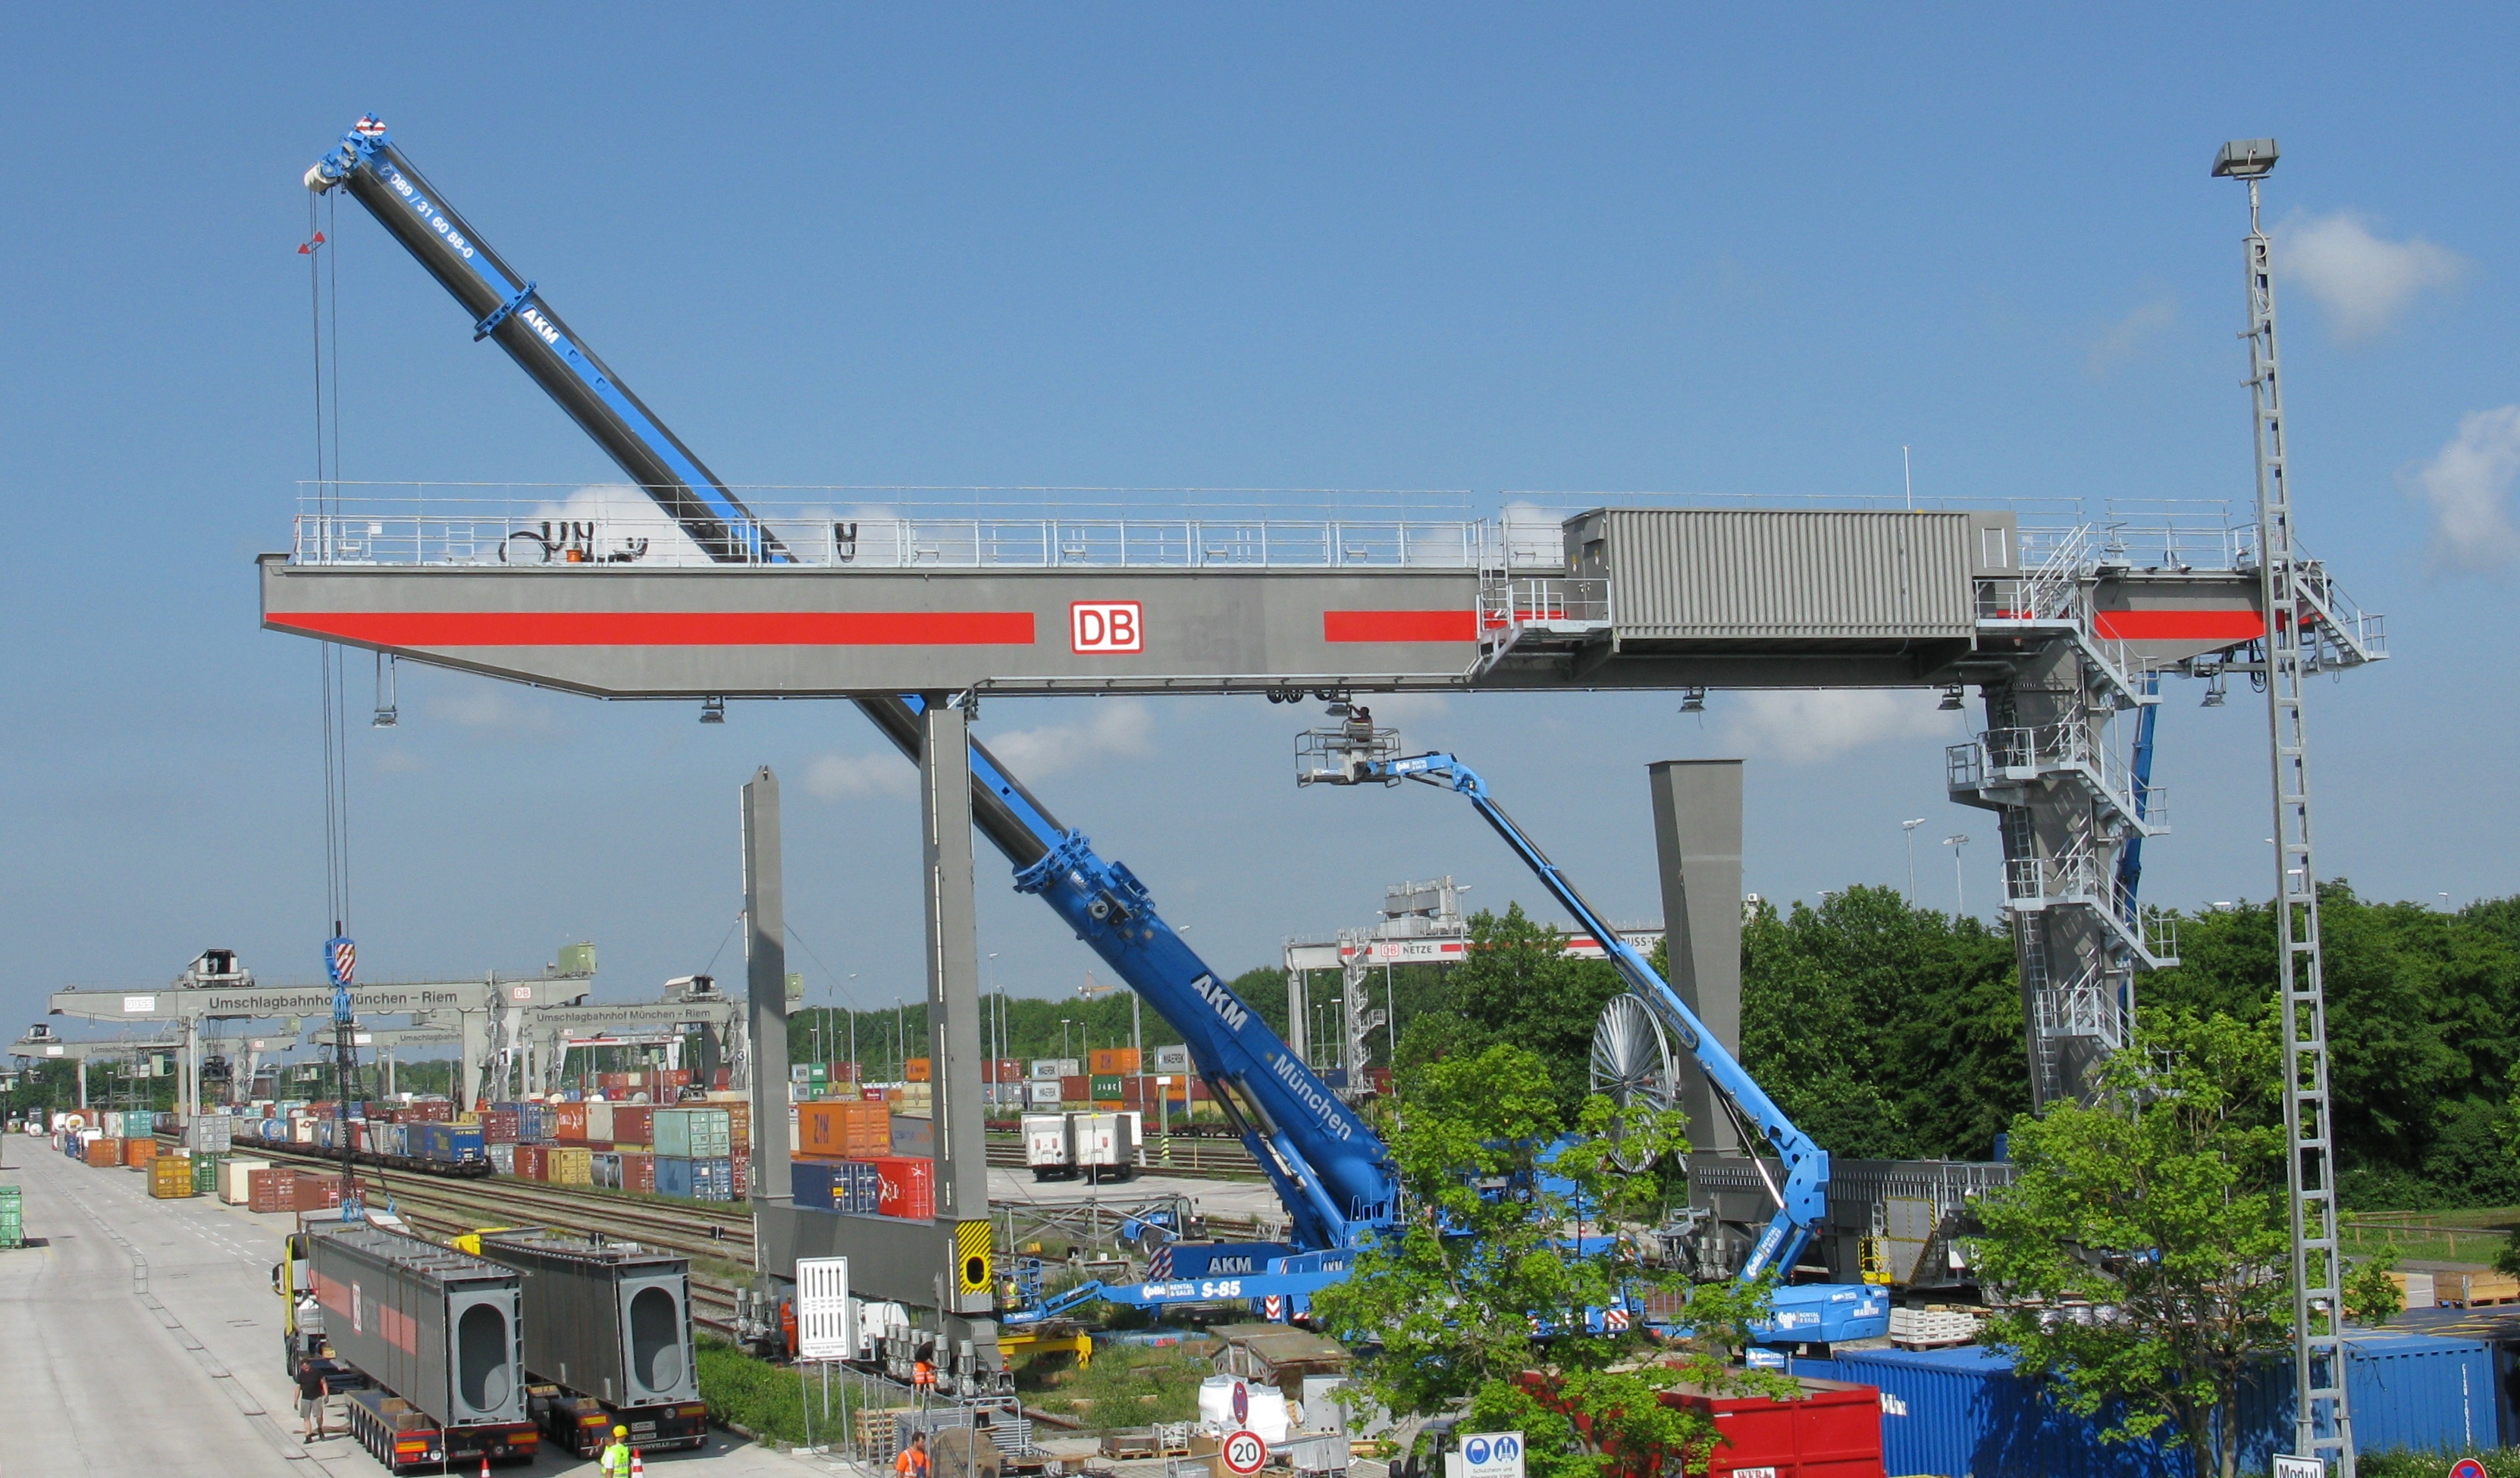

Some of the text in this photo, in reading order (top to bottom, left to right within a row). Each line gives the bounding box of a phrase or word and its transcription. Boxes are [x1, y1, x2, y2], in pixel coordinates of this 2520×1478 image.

[390, 173, 413, 197] 089
[417, 201, 434, 218] 31
[432, 216, 450, 234] 60
[447, 231, 474, 259] 88-0
[522, 307, 560, 345] AKM
[1079, 609, 1136, 646] DB
[1403, 945, 1432, 953] NETZE
[516, 988, 530, 997] DB
[209, 994, 334, 1011] Umschlagbahnho
[422, 991, 457, 1004] Riem
[1192, 973, 1248, 1032] AKM
[537, 1011, 627, 1025] Umschlagbahnhof
[630, 1009, 675, 1020] München
[685, 1009, 711, 1019] Riem
[400, 1034, 462, 1044] Umschlagbahnh
[737, 1051, 745, 1061] 3
[1272, 1053, 1352, 1141] München
[1209, 1257, 1252, 1272] AKM
[1322, 1259, 1343, 1272] AKM
[1747, 1251, 1764, 1277] Collé
[1142, 1285, 1166, 1299] Collé
[1201, 1280, 1241, 1298] S-85
[1777, 1311, 1797, 1324] Collé
[1233, 1442, 1259, 1463] 20
[2279, 1463, 2318, 1478] Modul
